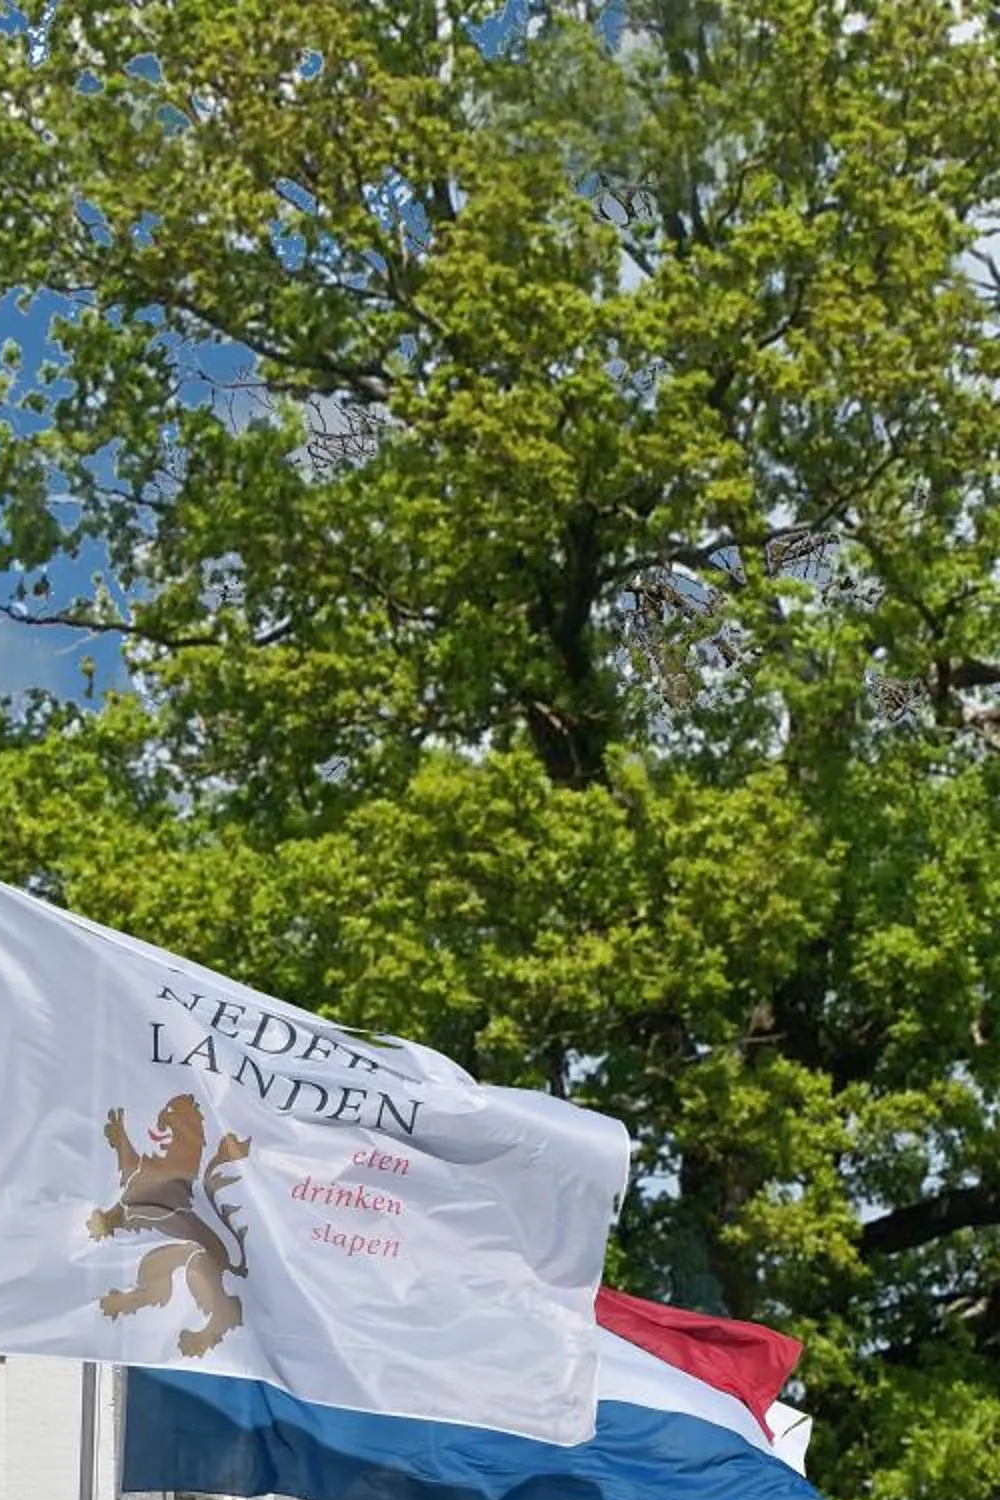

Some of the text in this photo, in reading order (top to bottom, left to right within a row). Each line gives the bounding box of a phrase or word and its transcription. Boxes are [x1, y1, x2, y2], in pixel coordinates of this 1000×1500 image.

[151, 1022, 424, 1135] LANDEN
[291, 1176, 402, 1215] drinken
[312, 1223, 400, 1257] slapen
